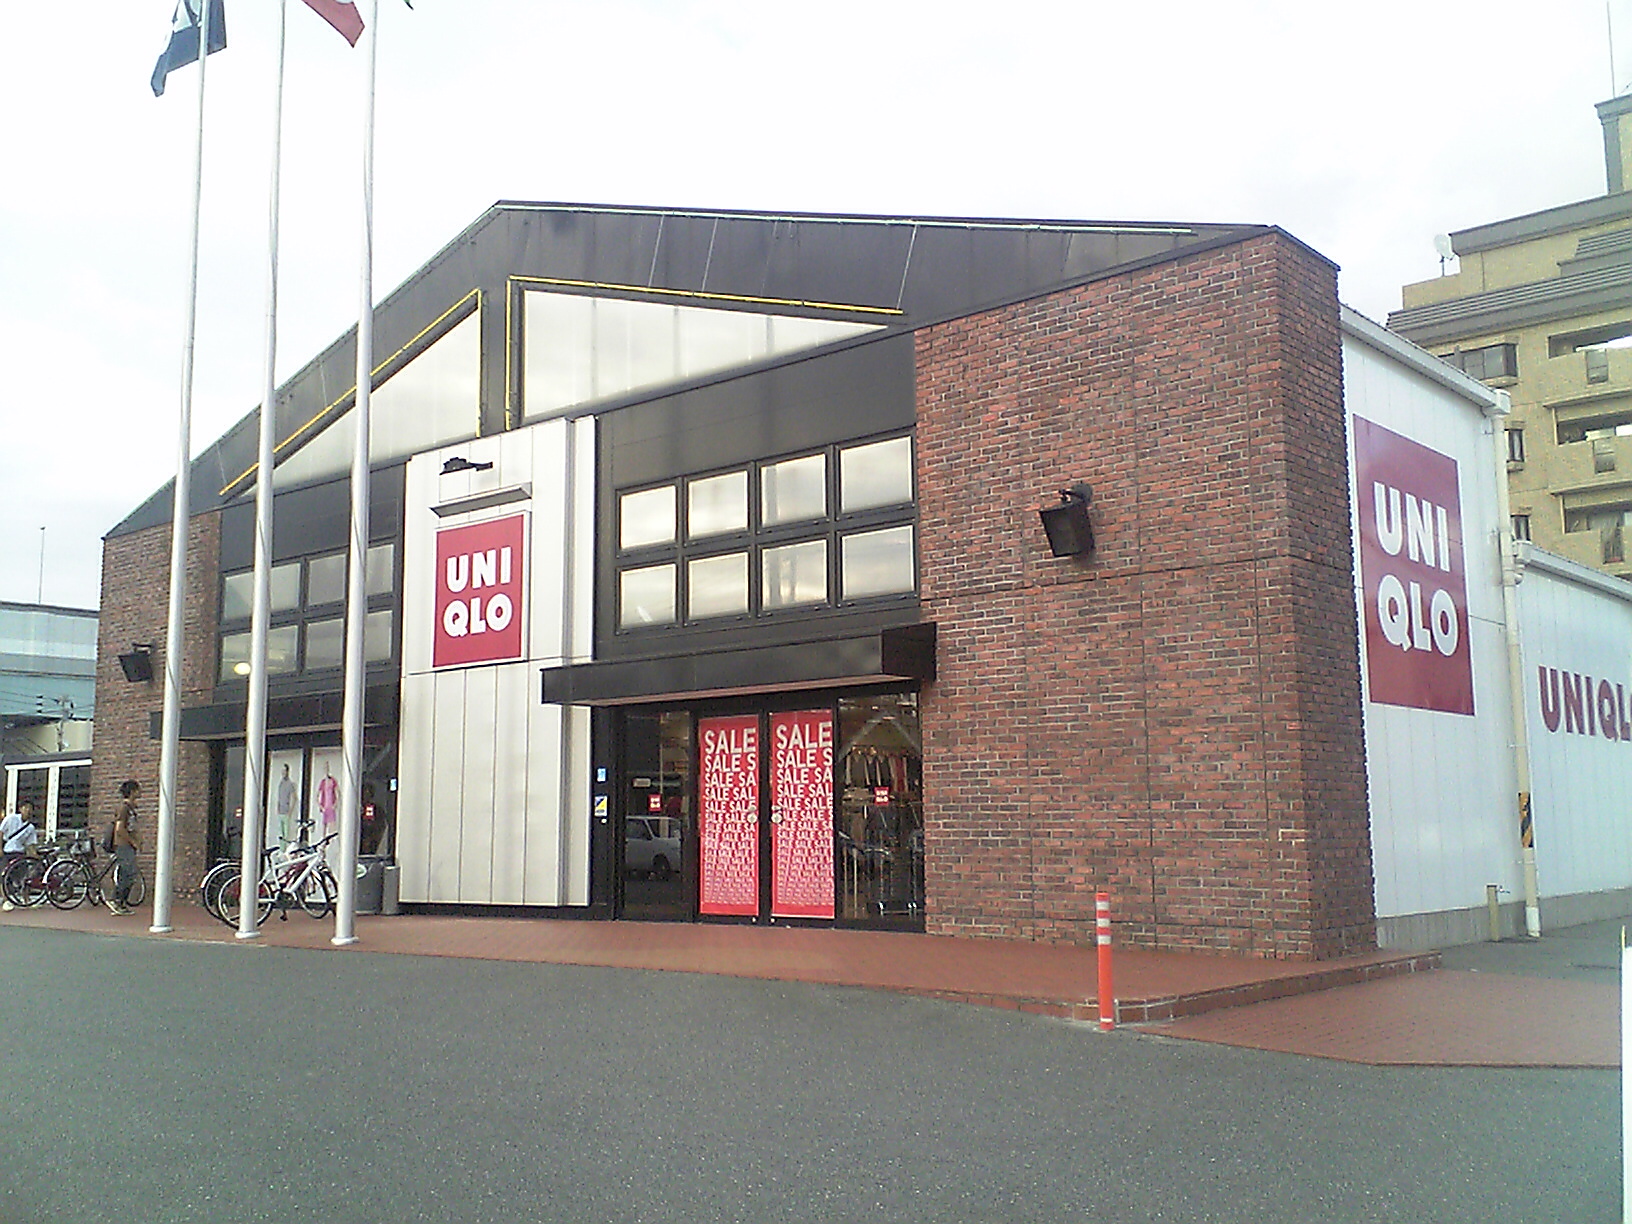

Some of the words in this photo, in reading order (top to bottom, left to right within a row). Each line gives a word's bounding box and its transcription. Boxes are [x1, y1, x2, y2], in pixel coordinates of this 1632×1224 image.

[1373, 481, 1451, 572] UNI
[446, 546, 512, 593] UNI
[443, 593, 513, 637] QLO
[1377, 574, 1459, 657] QLO
[1538, 663, 1632, 743] UNIQL
[705, 727, 756, 754] SALE
[776, 721, 832, 749] SALE
[705, 754, 741, 772] SALE
[747, 753, 756, 771] S
[776, 749, 817, 768] SALE
[823, 747, 833, 766] S
[705, 772, 734, 787] SALE
[739, 771, 756, 787] SA
[777, 767, 809, 784] SALE
[814, 767, 833, 783] SA
[705, 787, 729, 801] SALE
[733, 787, 755, 801] SAL
[777, 784, 804, 798] SALE
[808, 783, 833, 798] SAL
[705, 800, 726, 812] SALE
[804, 797, 833, 810] SALE
